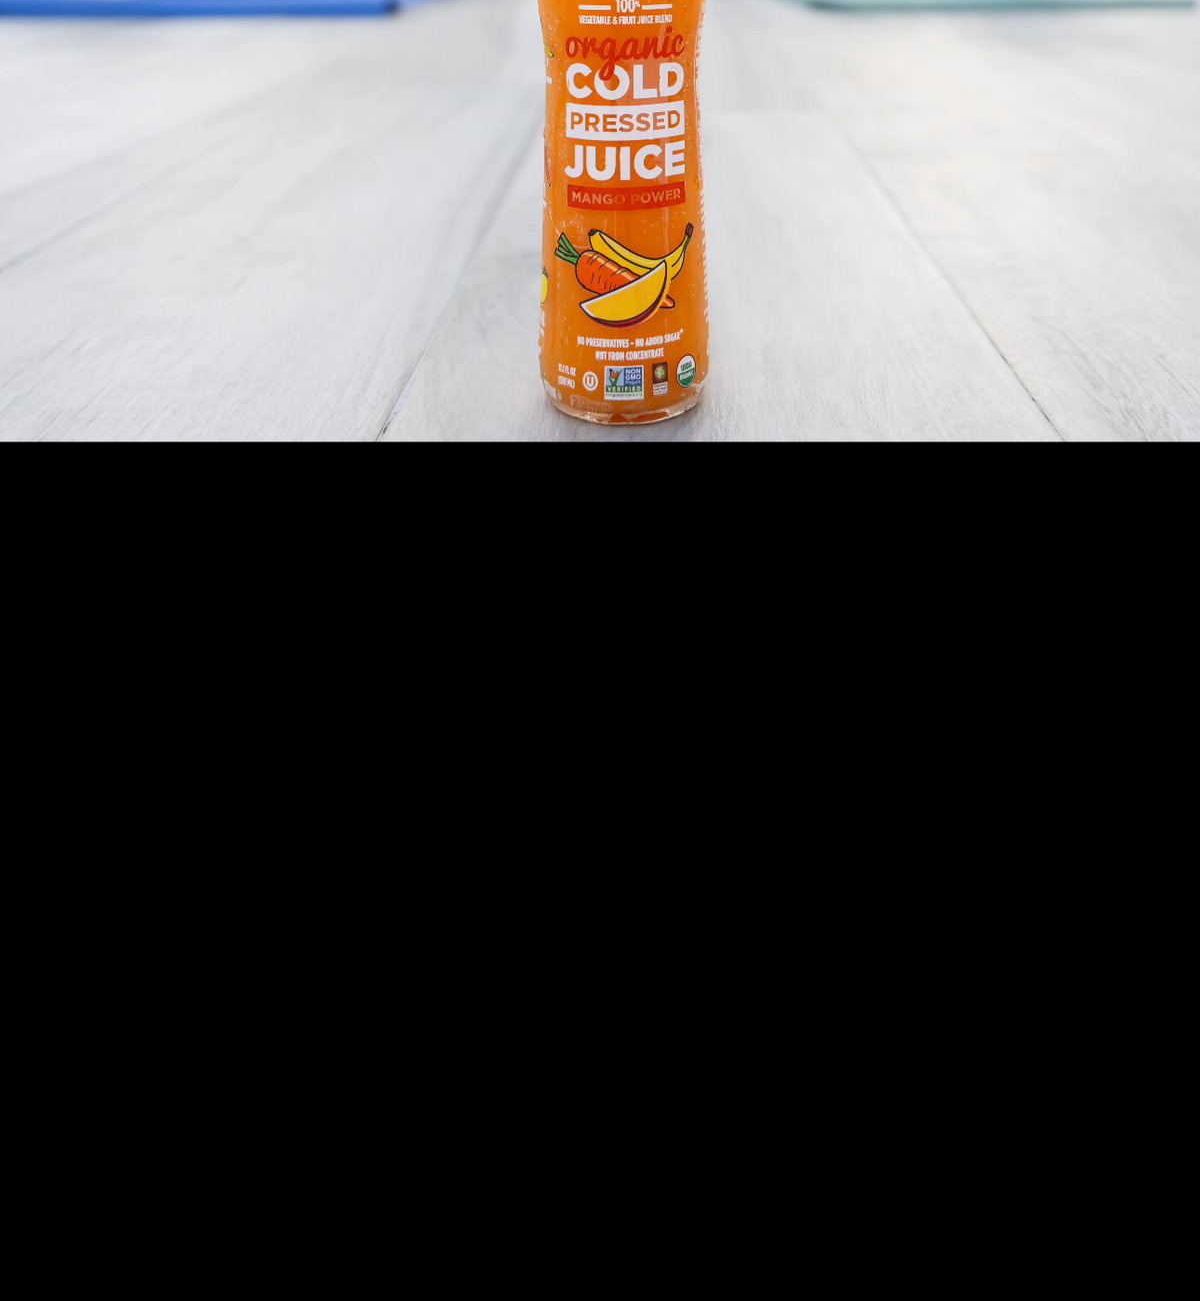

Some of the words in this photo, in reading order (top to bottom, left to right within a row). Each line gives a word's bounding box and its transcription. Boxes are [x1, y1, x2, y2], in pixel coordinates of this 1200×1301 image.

[579, 15, 611, 25] VEGETABLE
[612, 16, 617, 25] &
[619, 16, 636, 25] FRUIT
[637, 15, 654, 24] JUICE
[655, 14, 672, 23] BLEND
[565, 26, 686, 81] organic
[566, 62, 684, 100] COLD
[570, 110, 681, 133] PRESSED
[564, 140, 685, 181] JUICE
[572, 191, 626, 205] MANGO
[631, 188, 681, 204] POWER
[577, 335, 585, 345] NO
[586, 337, 629, 348] PRESERVATIVES
[635, 338, 644, 348] NO
[645, 335, 664, 347] ADDED
[595, 350, 607, 360] NOT
[608, 350, 625, 361] FROM
[626, 347, 664, 360] CONCENTRATE
